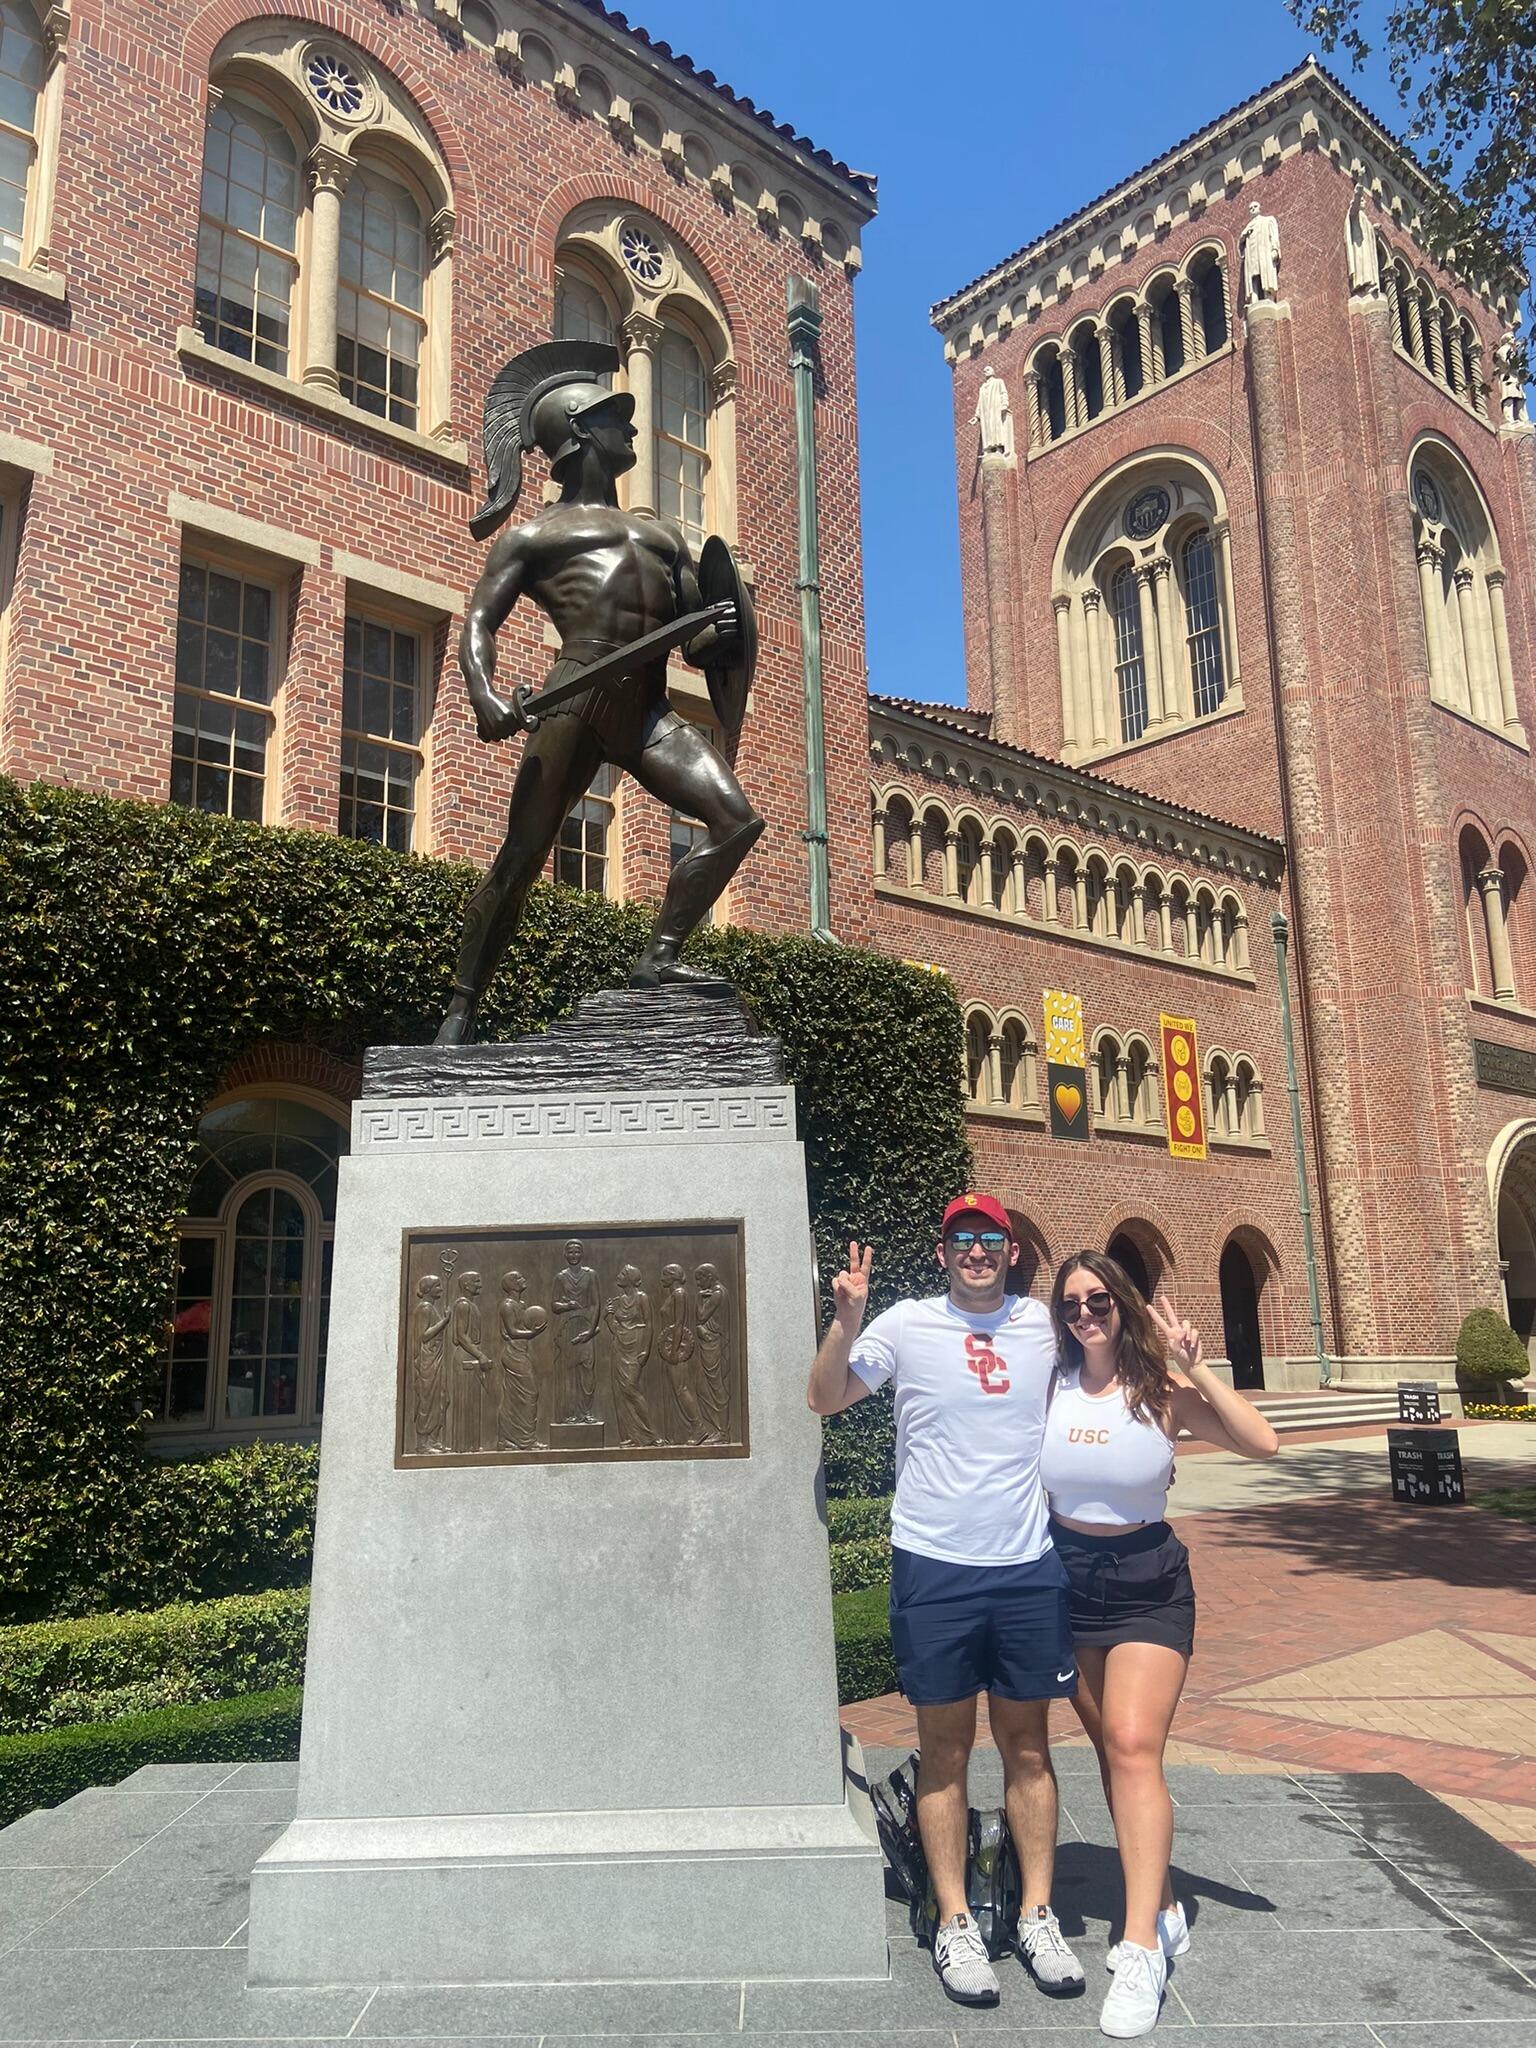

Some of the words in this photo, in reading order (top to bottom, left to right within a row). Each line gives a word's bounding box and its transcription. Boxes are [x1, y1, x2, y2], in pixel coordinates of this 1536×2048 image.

[1051, 1015, 1074, 1032] CARE
[1163, 1019, 1183, 1029] UNITED
[1174, 1143, 1190, 1153] FIGHT
[965, 1333, 1010, 1394] SC
[1068, 1428, 1109, 1444] USC
[1398, 1451, 1423, 1460] TRASH
